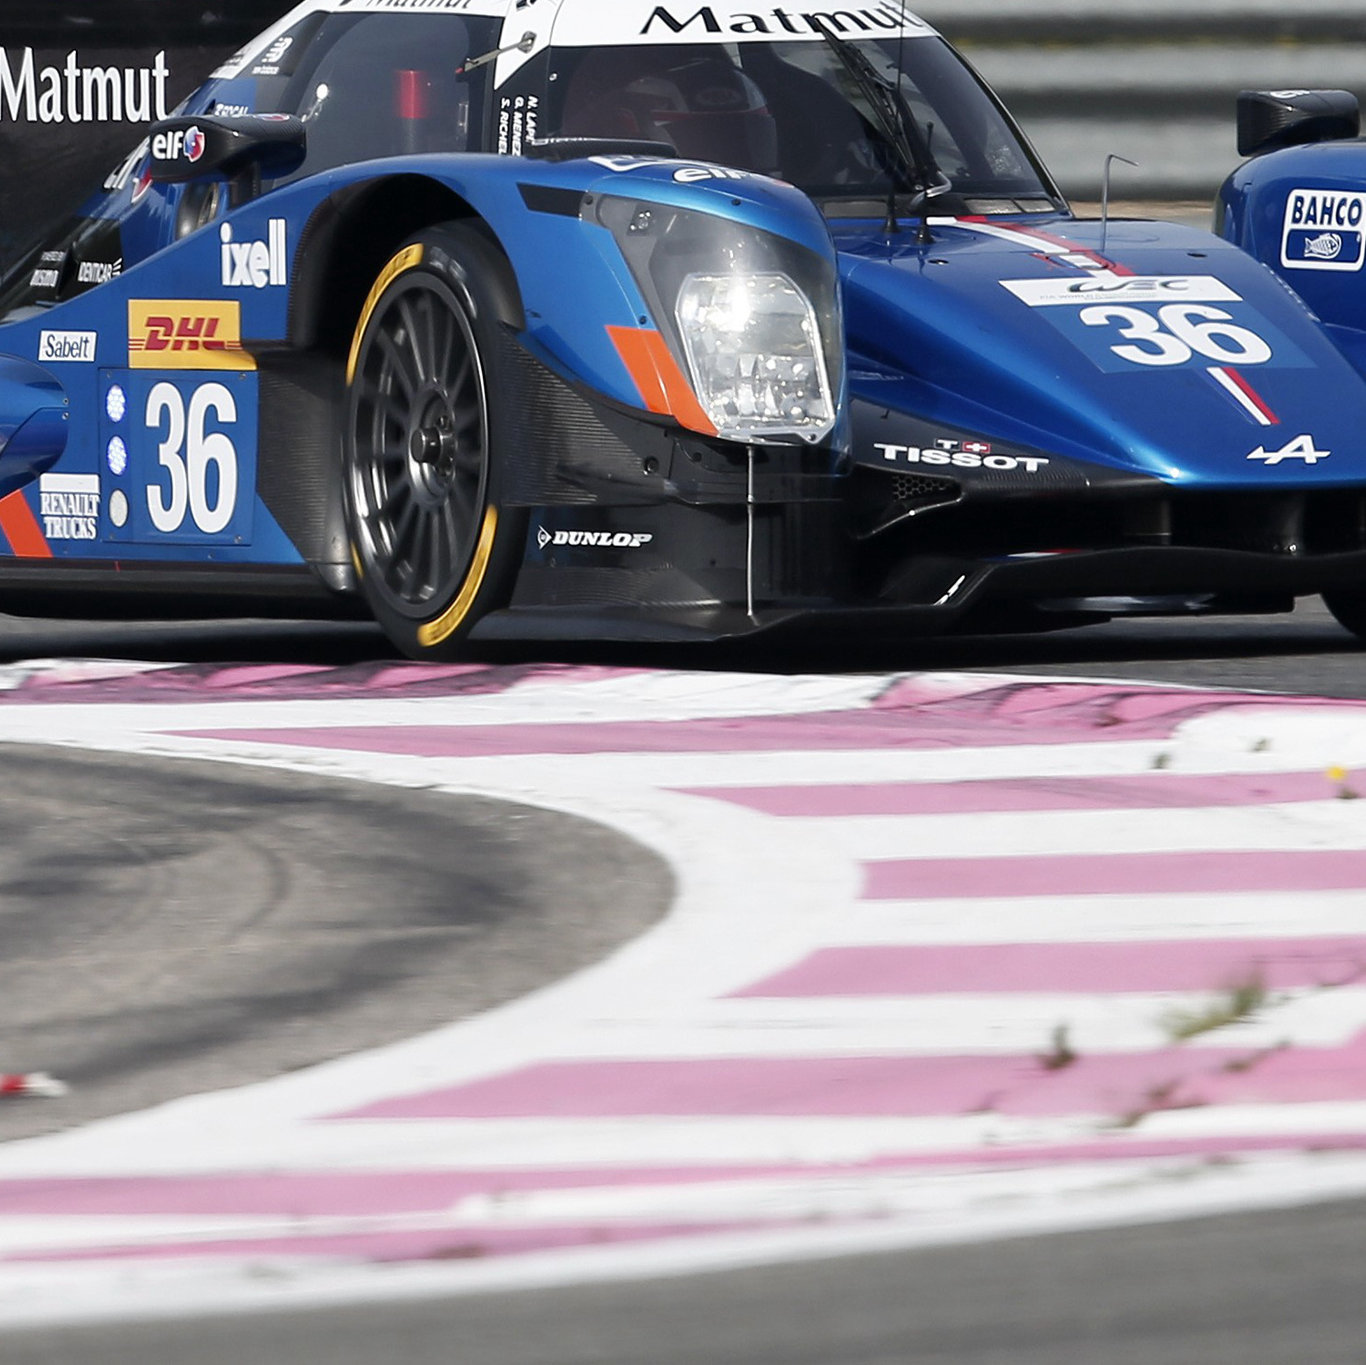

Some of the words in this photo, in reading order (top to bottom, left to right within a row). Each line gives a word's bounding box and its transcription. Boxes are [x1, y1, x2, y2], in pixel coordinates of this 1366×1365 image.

[640, 0, 924, 35] Matmut
[152, 131, 184, 160] elf
[1291, 194, 1362, 227] BAHCO
[220, 218, 287, 288] ixell
[1067, 279, 1189, 293] WEC
[45, 333, 90, 359] Sabelt
[144, 316, 226, 351] DHL
[1079, 303, 1272, 366] 36
[145, 381, 238, 533] 36
[873, 442, 1050, 473] TISSOT
[40, 493, 100, 517] RENAULT
[44, 518, 97, 540] TRUCKS
[552, 530, 653, 547] DUNLOP
